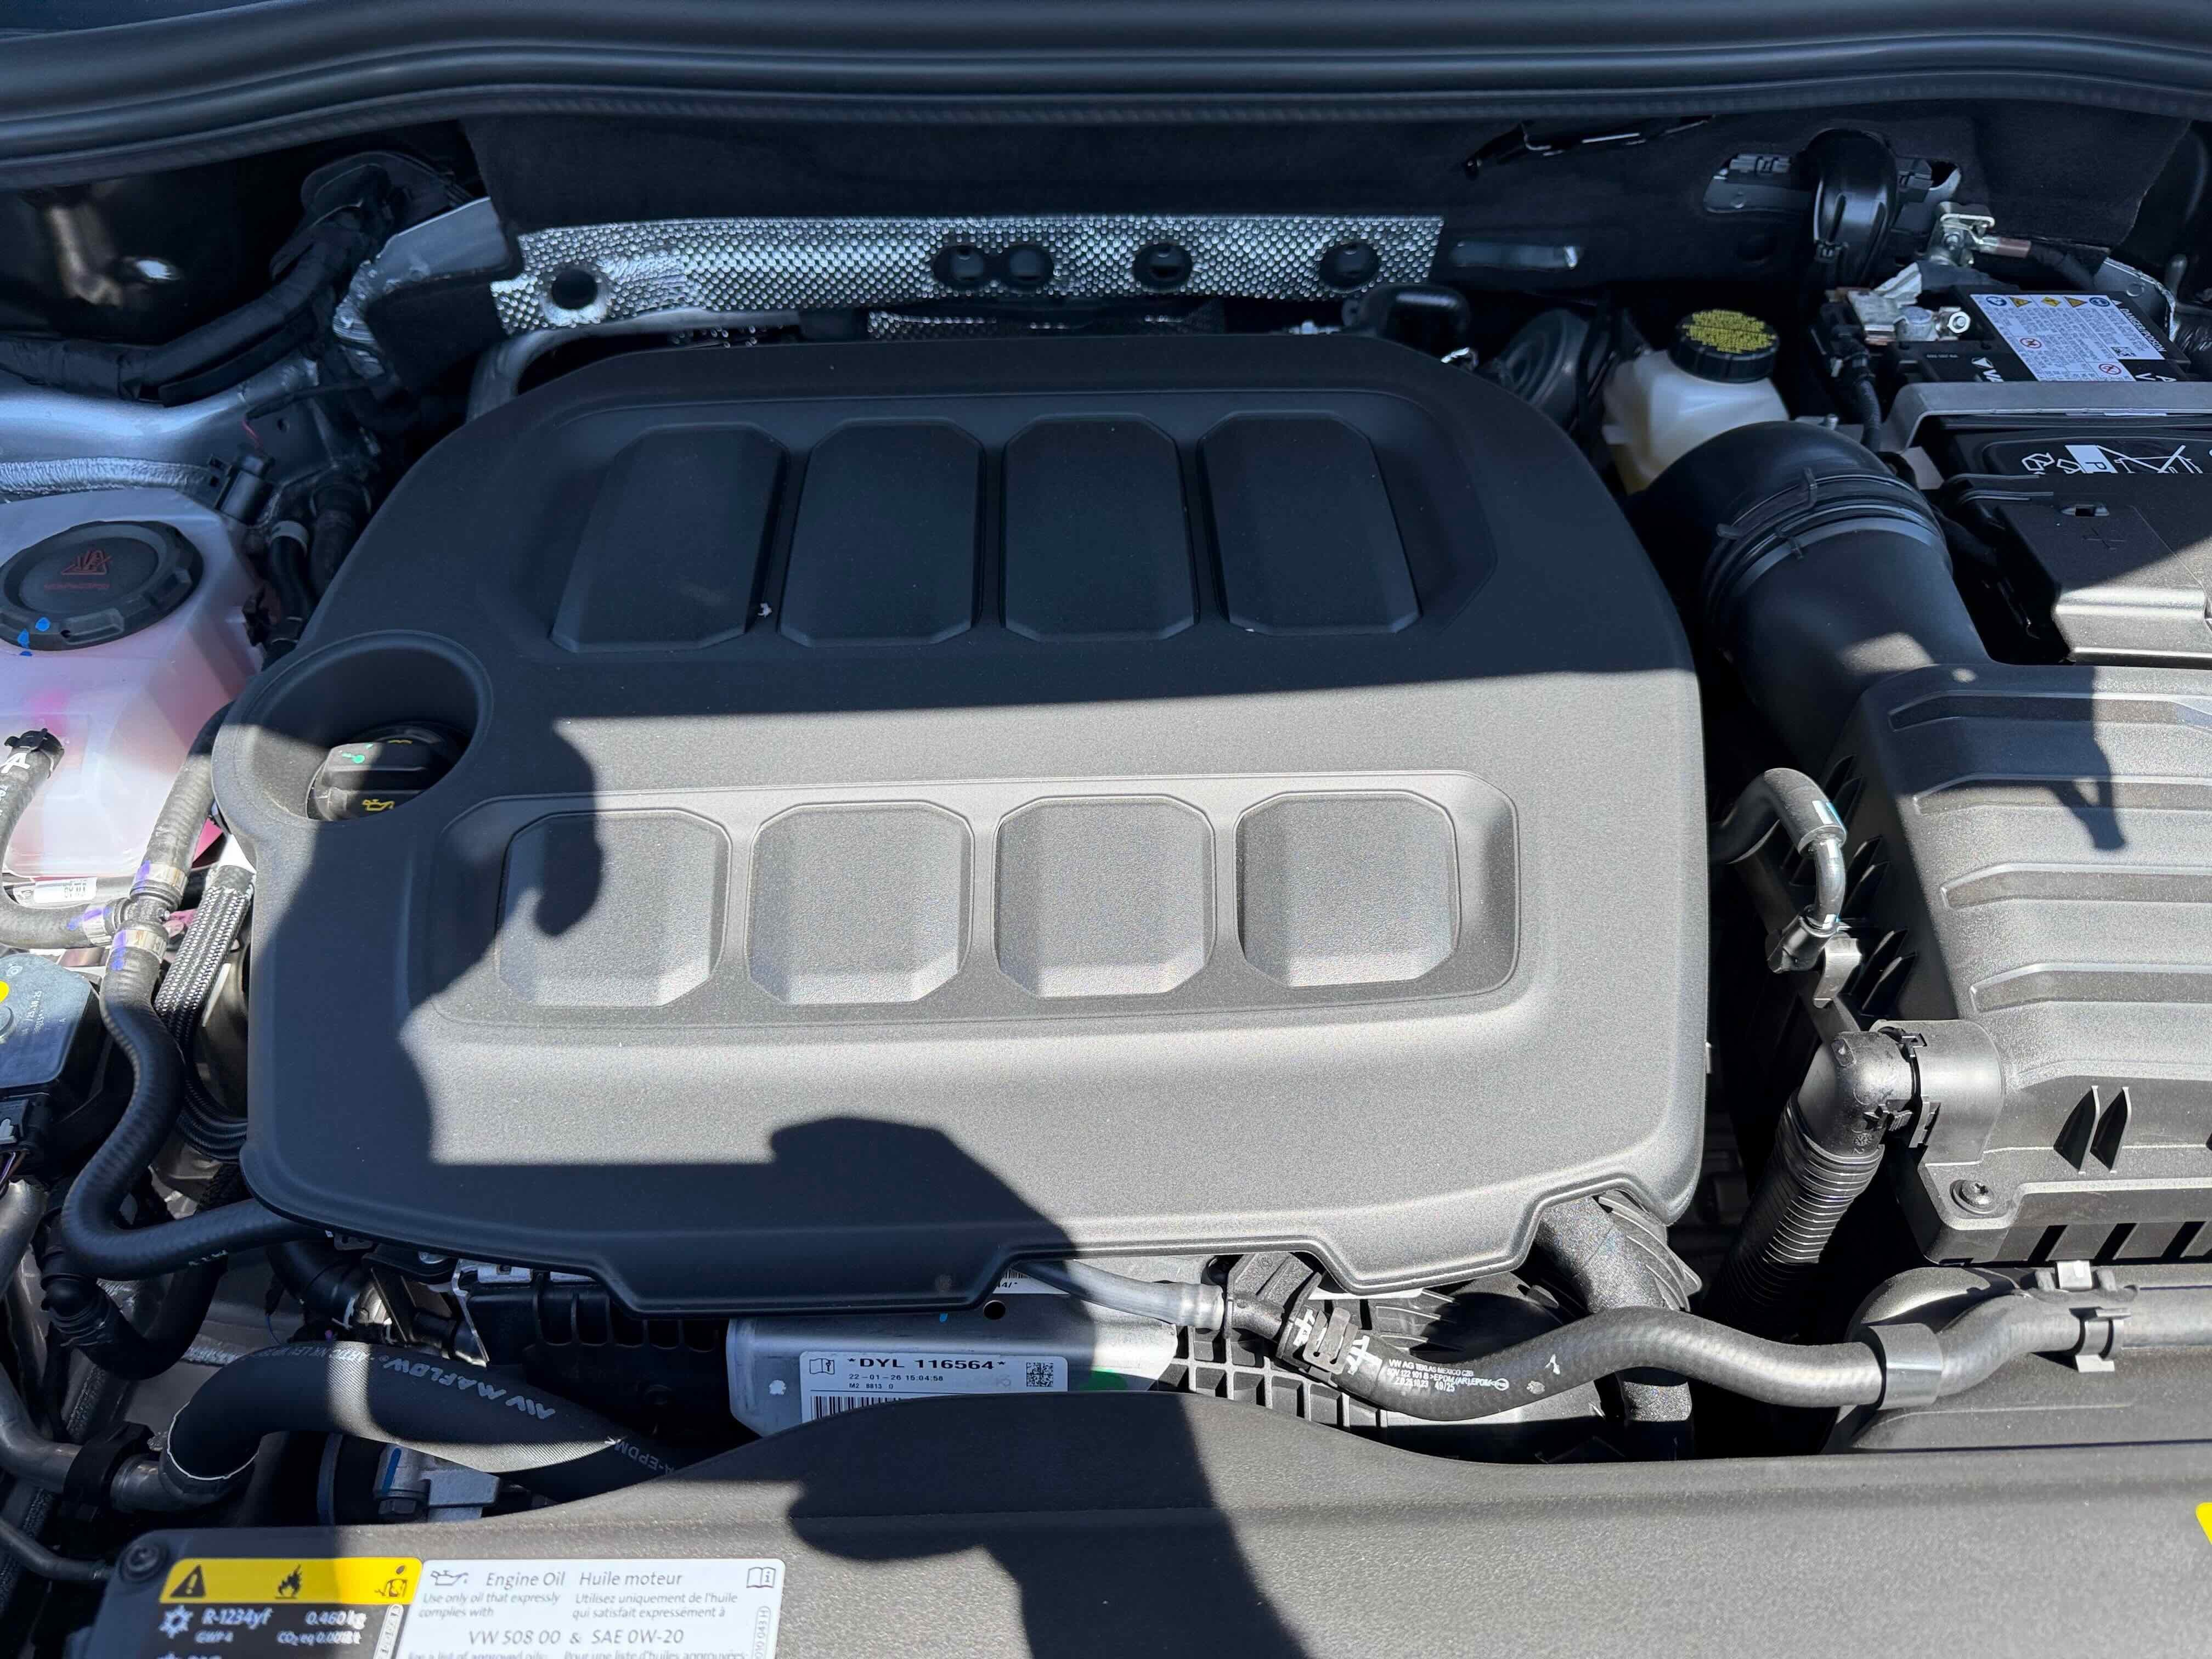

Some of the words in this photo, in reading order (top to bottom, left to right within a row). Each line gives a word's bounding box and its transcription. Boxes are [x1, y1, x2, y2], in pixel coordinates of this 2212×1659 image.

[1389, 1359, 1402, 1368] VW
[1402, 1361, 1414, 1370] AG
[1415, 1363, 1437, 1373] TEKLAS
[1437, 1367, 1461, 1376] MEXICO
[486, 1571, 539, 1590] Engine
[543, 1571, 566, 1587] Oil
[579, 1571, 620, 1586] Huile
[624, 1571, 682, 1586] moteur
[422, 1593, 444, 1604] Use
[445, 1592, 467, 1605] only
[470, 1592, 484, 1603] oil
[486, 1592, 509, 1603] that
[511, 1591, 561, 1605] expressly
[575, 1593, 616, 1604] Utilisez
[618, 1593, 686, 1606] uniquement
[689, 1592, 702, 1604] de
[704, 1592, 738, 1604] l'huile
[201, 1606, 273, 1630] R-1234yf
[419, 1606, 466, 1620] complies
[470, 1606, 495, 1617] with
[572, 1608, 590, 1621] qui
[592, 1606, 637, 1618] satisfait
[639, 1607, 716, 1621] expressément
[719, 1606, 726, 1618] à
[468, 1629, 499, 1645] VW
[501, 1629, 534, 1645] 508
[538, 1629, 562, 1645] 00
[569, 1632, 582, 1645] &
[590, 1628, 624, 1645] SAE
[627, 1628, 685, 1644] 0W-20
